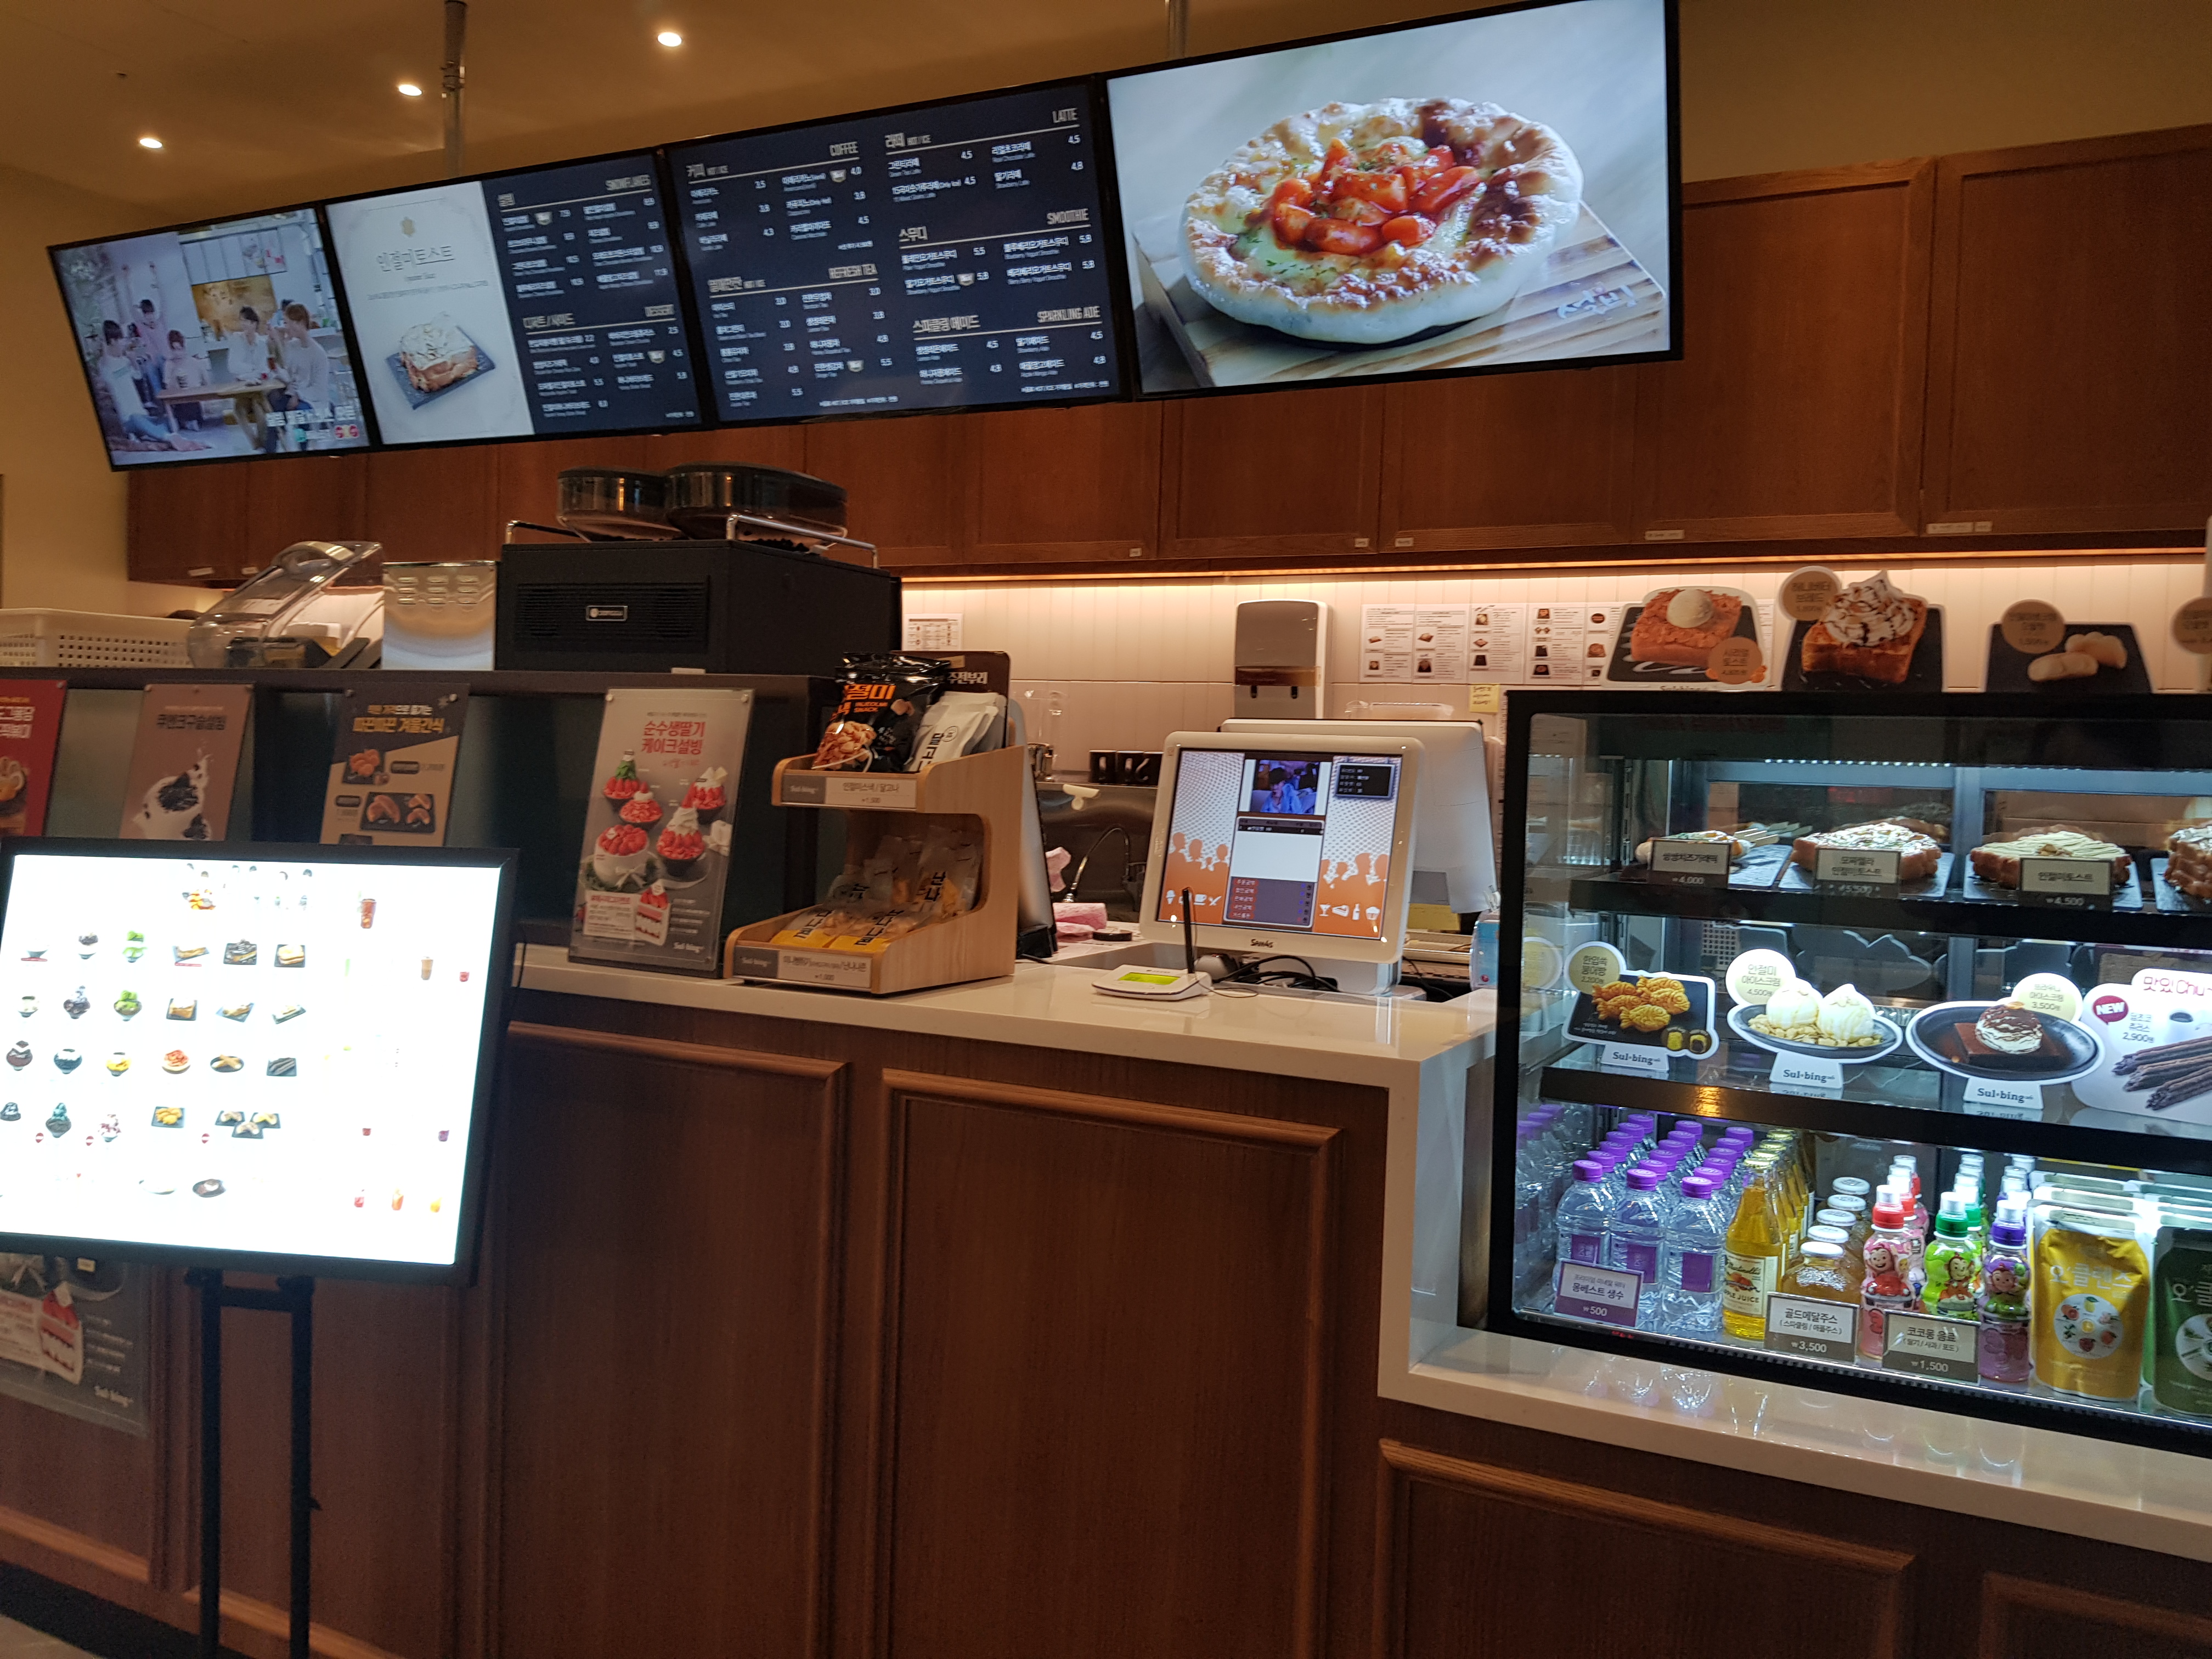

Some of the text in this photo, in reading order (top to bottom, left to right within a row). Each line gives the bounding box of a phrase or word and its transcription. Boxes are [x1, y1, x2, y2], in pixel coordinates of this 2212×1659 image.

[644, 720, 706, 737] 순수생딸기
[641, 738, 703, 755] 케이크설빙
[1748, 964, 1776, 977] 인절미
[1741, 975, 1781, 987] 아이스크림
[2029, 992, 2064, 1003] 아이스크림
[2096, 1002, 2125, 1015] NEW
[1572, 1283, 1624, 1299] 몽베스트 생수
[1737, 1294, 1760, 1303] JUICE
[1785, 1308, 1838, 1323] 골드메달주스
[1906, 1327, 1957, 1342] 코코몽 음료
